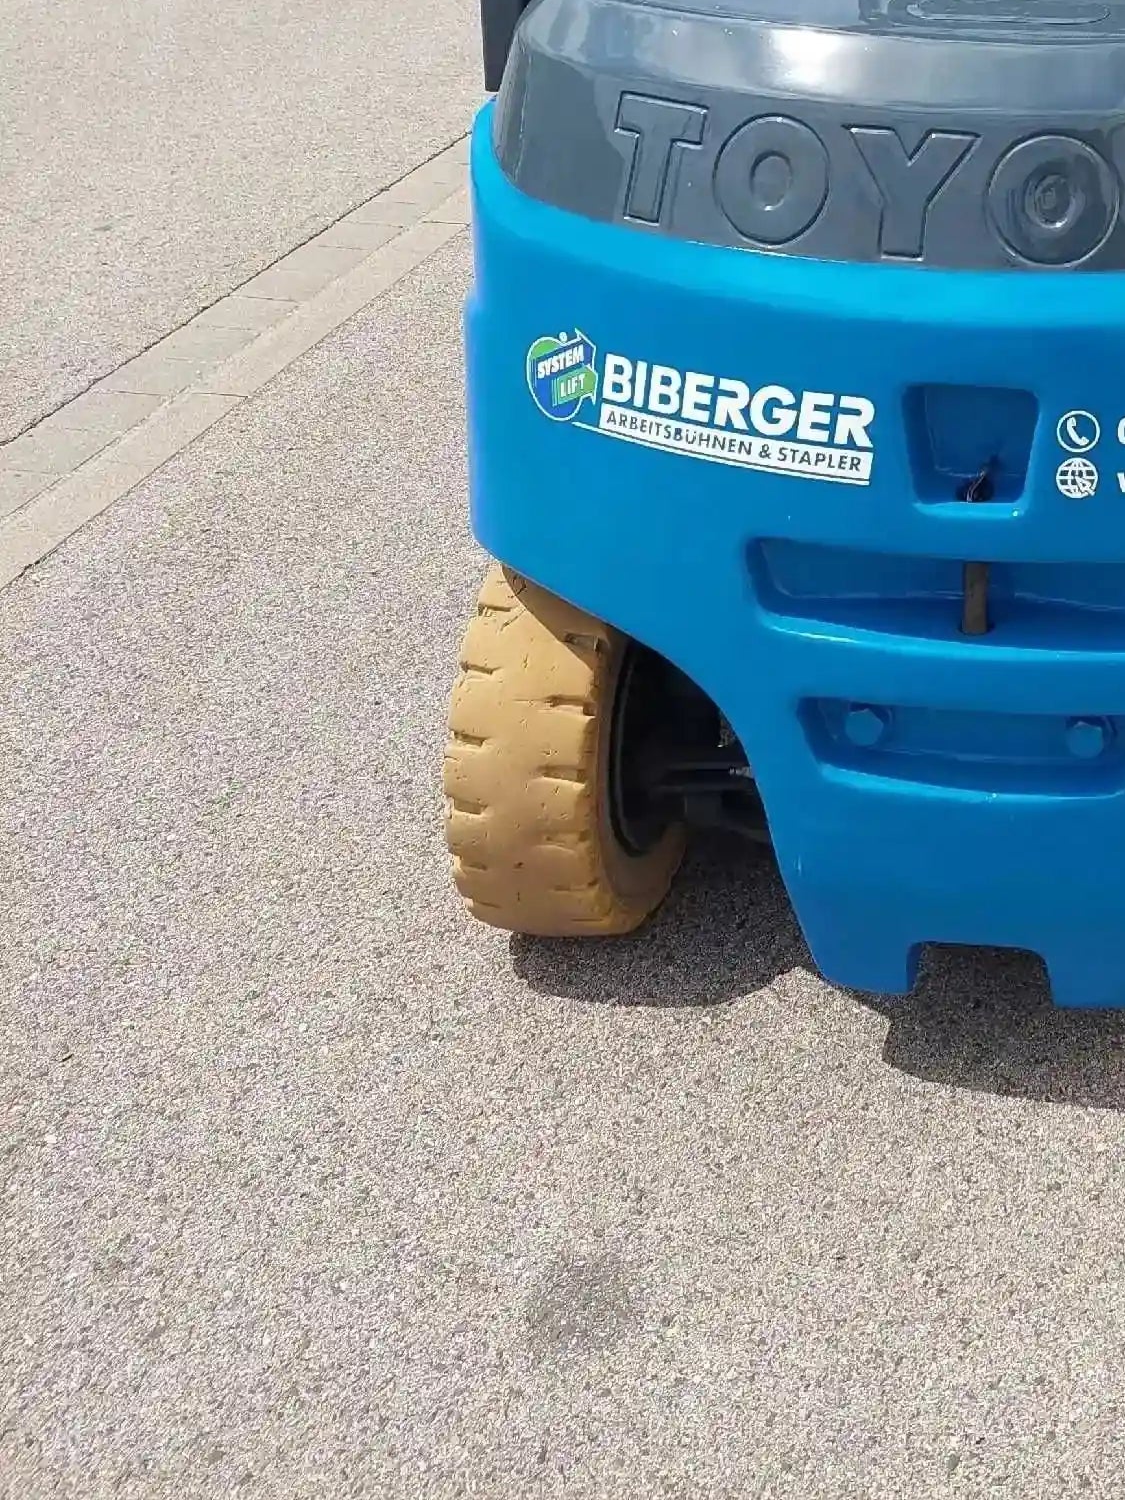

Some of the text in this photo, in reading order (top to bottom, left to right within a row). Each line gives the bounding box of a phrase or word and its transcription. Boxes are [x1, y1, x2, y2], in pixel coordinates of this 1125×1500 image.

[537, 343, 585, 379] SYSTEM
[560, 373, 586, 398] LIFT
[602, 353, 875, 448] BIBERGER
[606, 410, 862, 472] ARBEITSBÜHNEN & STAPLER
